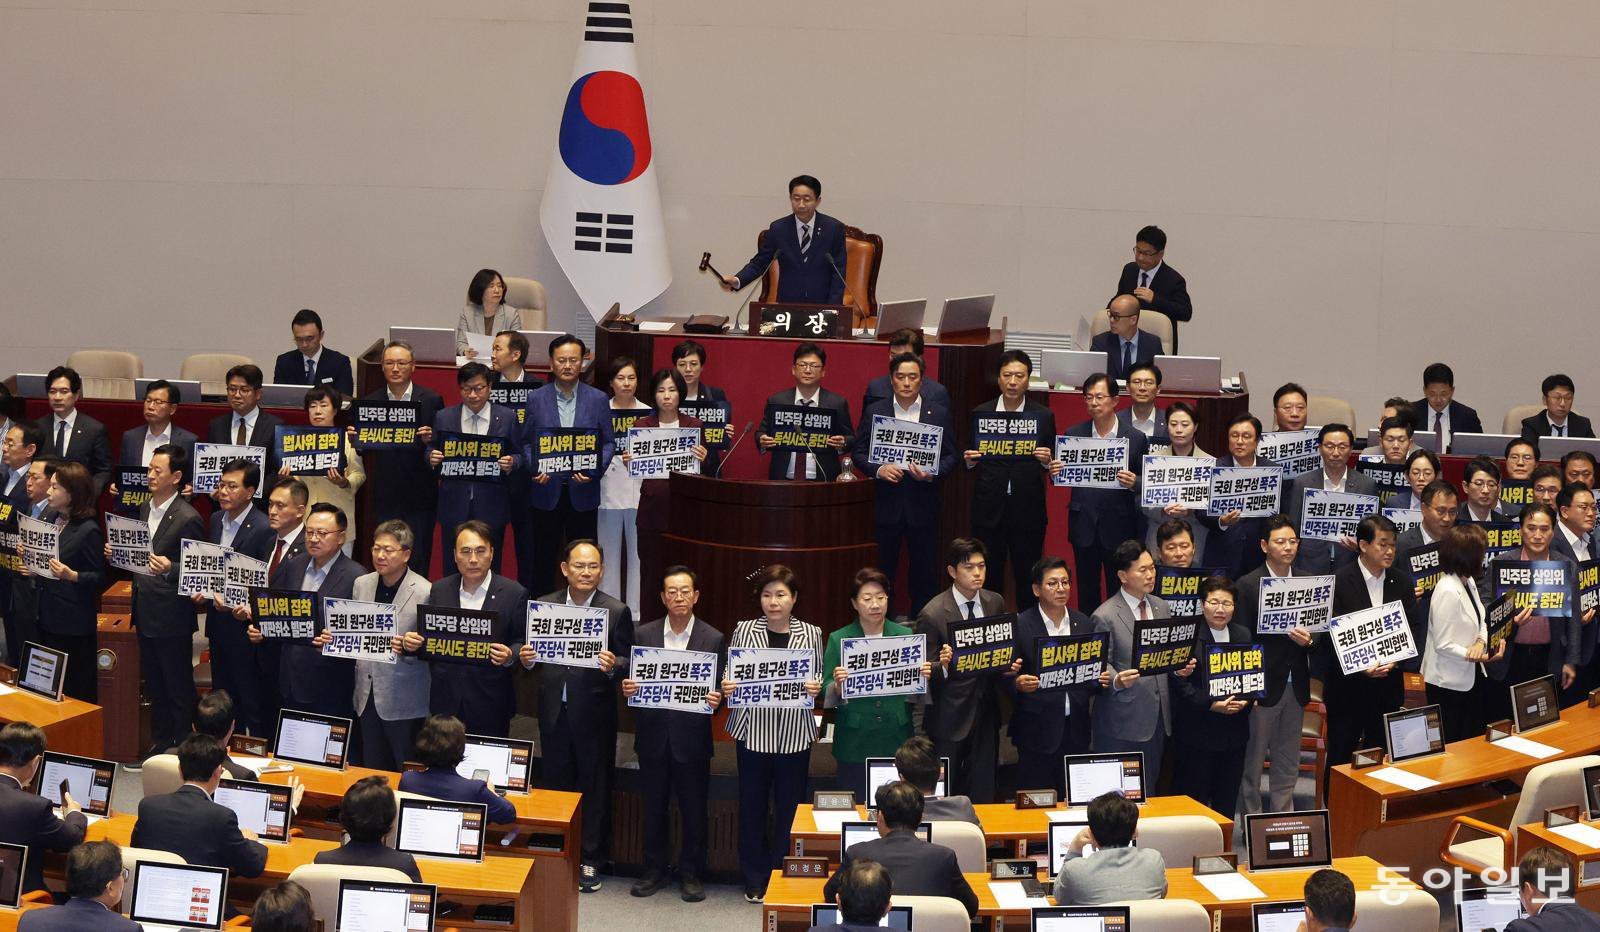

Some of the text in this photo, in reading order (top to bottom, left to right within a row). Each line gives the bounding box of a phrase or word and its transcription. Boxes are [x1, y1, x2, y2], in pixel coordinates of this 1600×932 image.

[775, 311, 828, 334] 의장
[490, 389, 534, 403] 주당 상임
[359, 407, 416, 423] 민주당 상임위
[699, 408, 726, 423] 상임위
[775, 412, 832, 429] 민주당 상임위
[358, 427, 415, 444] 독식시도 중단!
[978, 419, 1037, 434] 민주당 상임위
[283, 434, 339, 452] 법사위 집착
[539, 435, 573, 453] 법사위
[575, 434, 596, 450] 집착
[633, 440, 650, 454] 국회
[652, 438, 677, 453] 원구성
[678, 436, 696, 451] 폭주
[704, 428, 724, 444] 중단!
[774, 432, 829, 448] 독식시도 중단!
[876, 428, 938, 449] 국회 원구성 폭주
[444, 441, 502, 459] 법사위 집착
[872, 446, 936, 467] 민주당식 국민협박
[978, 440, 1036, 455] 독식시도 중단!
[1060, 447, 1124, 464] 국회 원구성 폭주
[1259, 438, 1320, 459] 국회 원구성 폭주
[199, 457, 216, 471] 국회
[282, 453, 339, 470] 재판취소 빌드업
[441, 461, 501, 476] 재판취소 빌드업
[538, 454, 597, 473] 재판취소 빌드업
[631, 455, 695, 475] 민주당식 국민협박
[1292, 457, 1322, 474] 국민협박
[196, 475, 220, 490] 민주당
[1058, 468, 1091, 483] 민주당식
[1148, 468, 1211, 483] 국회 원구성 폭주
[1214, 475, 1278, 494] 국회 원구성 폭주
[122, 490, 150, 505] 독식시
[1145, 487, 1210, 504] 민주당식 국민협박
[1500, 487, 1524, 503] 사위
[1211, 495, 1276, 514] 민주당식 국민협박
[1308, 503, 1325, 516] 국회
[1328, 503, 1354, 517] 원구성
[110, 528, 149, 546] 국회 원구성 폭주
[1304, 520, 1338, 536] 민주당식
[29, 530, 43, 546] 원구성
[44, 533, 55, 550] 폭주
[185, 555, 217, 571] 국회 원구성
[1410, 551, 1439, 571] 민주당
[182, 576, 208, 592] 민주당식
[228, 566, 266, 588] 국회 원구성 폭주
[1161, 577, 1199, 595] 법사위
[1500, 569, 1564, 585] 민주당 상임위
[226, 587, 249, 606] 민주당식
[1265, 585, 1331, 608] 국회 원구성 폭주
[1540, 592, 1564, 609] 중단!
[257, 598, 311, 616] 법사위 집착
[1168, 599, 1195, 616] 판취소
[330, 613, 394, 631] 국회 원구성 폭주
[425, 613, 492, 636] 민주당 상임위
[532, 617, 604, 636] 국회 원구성 폭주
[1261, 607, 1329, 630] 민주당식 국민협박
[259, 621, 314, 638] 재판취소 빌드업
[955, 622, 1013, 648] 민주당 상임위
[1141, 624, 1196, 645] 민주당 상임위
[1338, 611, 1403, 647] 국회 원구성 폭주
[327, 636, 393, 654] 민주당식 국민협박
[426, 639, 492, 660] 독식시도 중단!
[529, 640, 603, 659] 민주당식 국민협박
[1042, 640, 1102, 667] 법사위 집착
[1343, 632, 1409, 671] 민주당식 국민협박
[848, 644, 921, 671] 국회 원구성 폭주
[956, 647, 1013, 673] 독식시도 중단!
[1140, 646, 1191, 670] 독식시도 중단!
[1209, 650, 1262, 674] 법사위 집착
[635, 662, 712, 681] 국회 원구성 폭주
[734, 658, 810, 681] 국회 원구성 폭주
[1039, 661, 1103, 689] 재판취소 빌드업
[846, 669, 921, 695] 민주당식 국민협박
[1209, 672, 1265, 697] 재판취소 빌드업
[633, 685, 710, 704] 민주당식 국민협박
[732, 685, 771, 705] 민주당식
